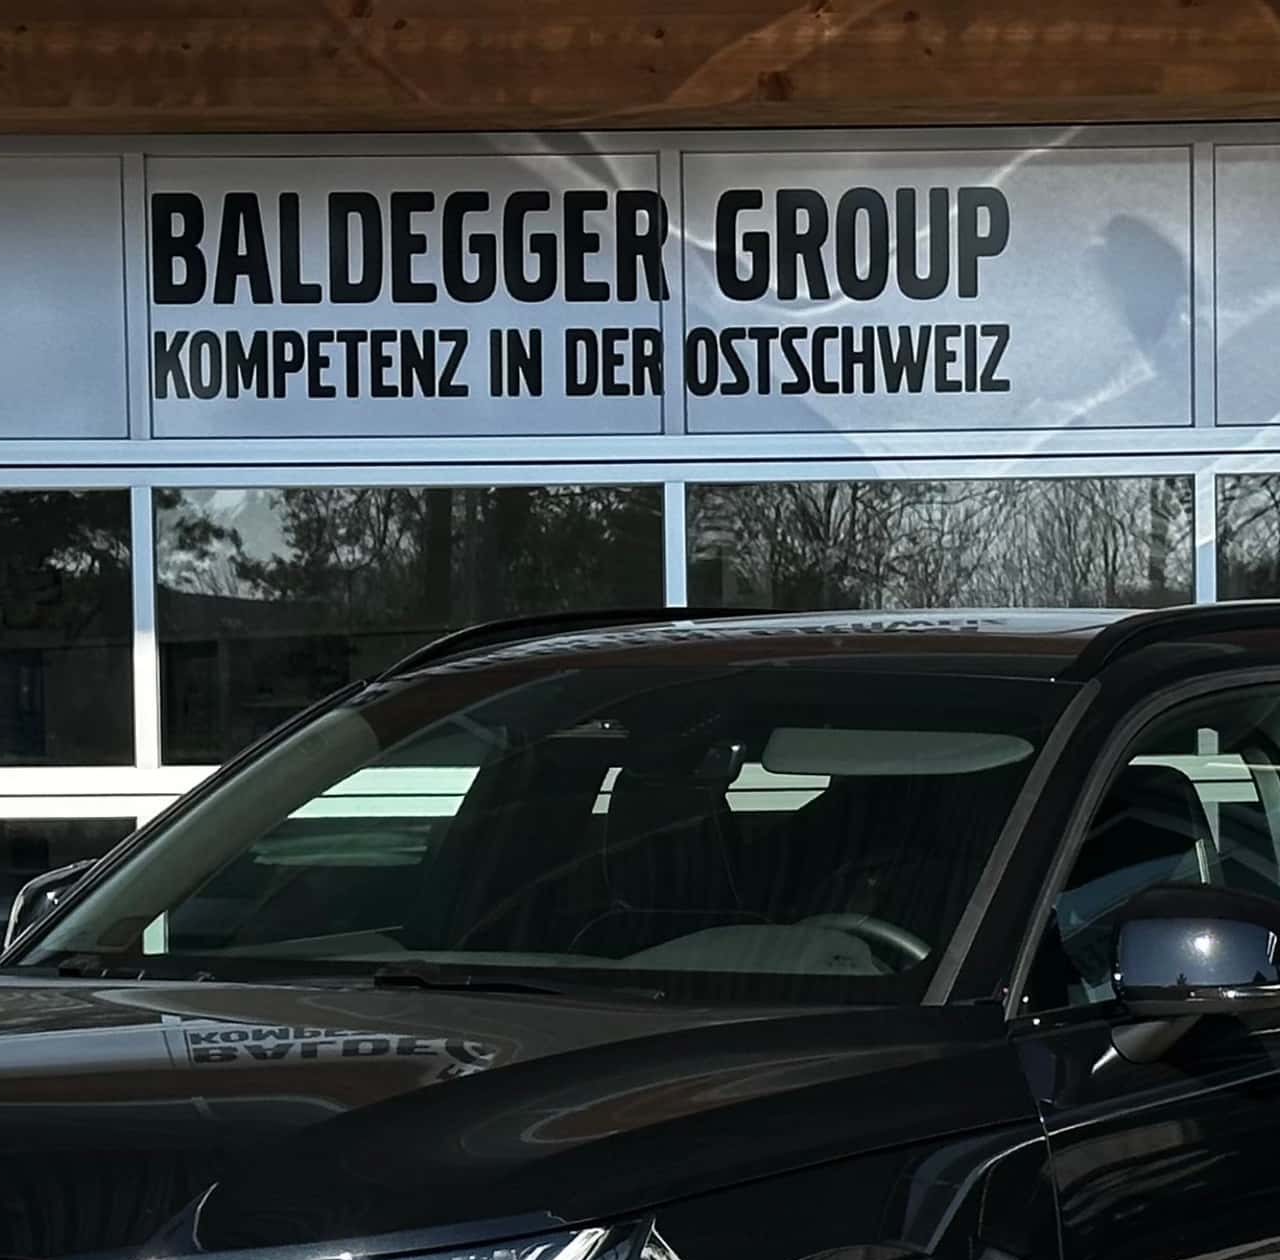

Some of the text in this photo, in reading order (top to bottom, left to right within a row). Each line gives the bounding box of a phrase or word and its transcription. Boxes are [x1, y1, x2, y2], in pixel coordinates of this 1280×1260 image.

[151, 186, 1011, 305] BALDEGGER GROUP
[153, 324, 1011, 400] KOMPETENZ IN DER OSTSCHWEIZ
